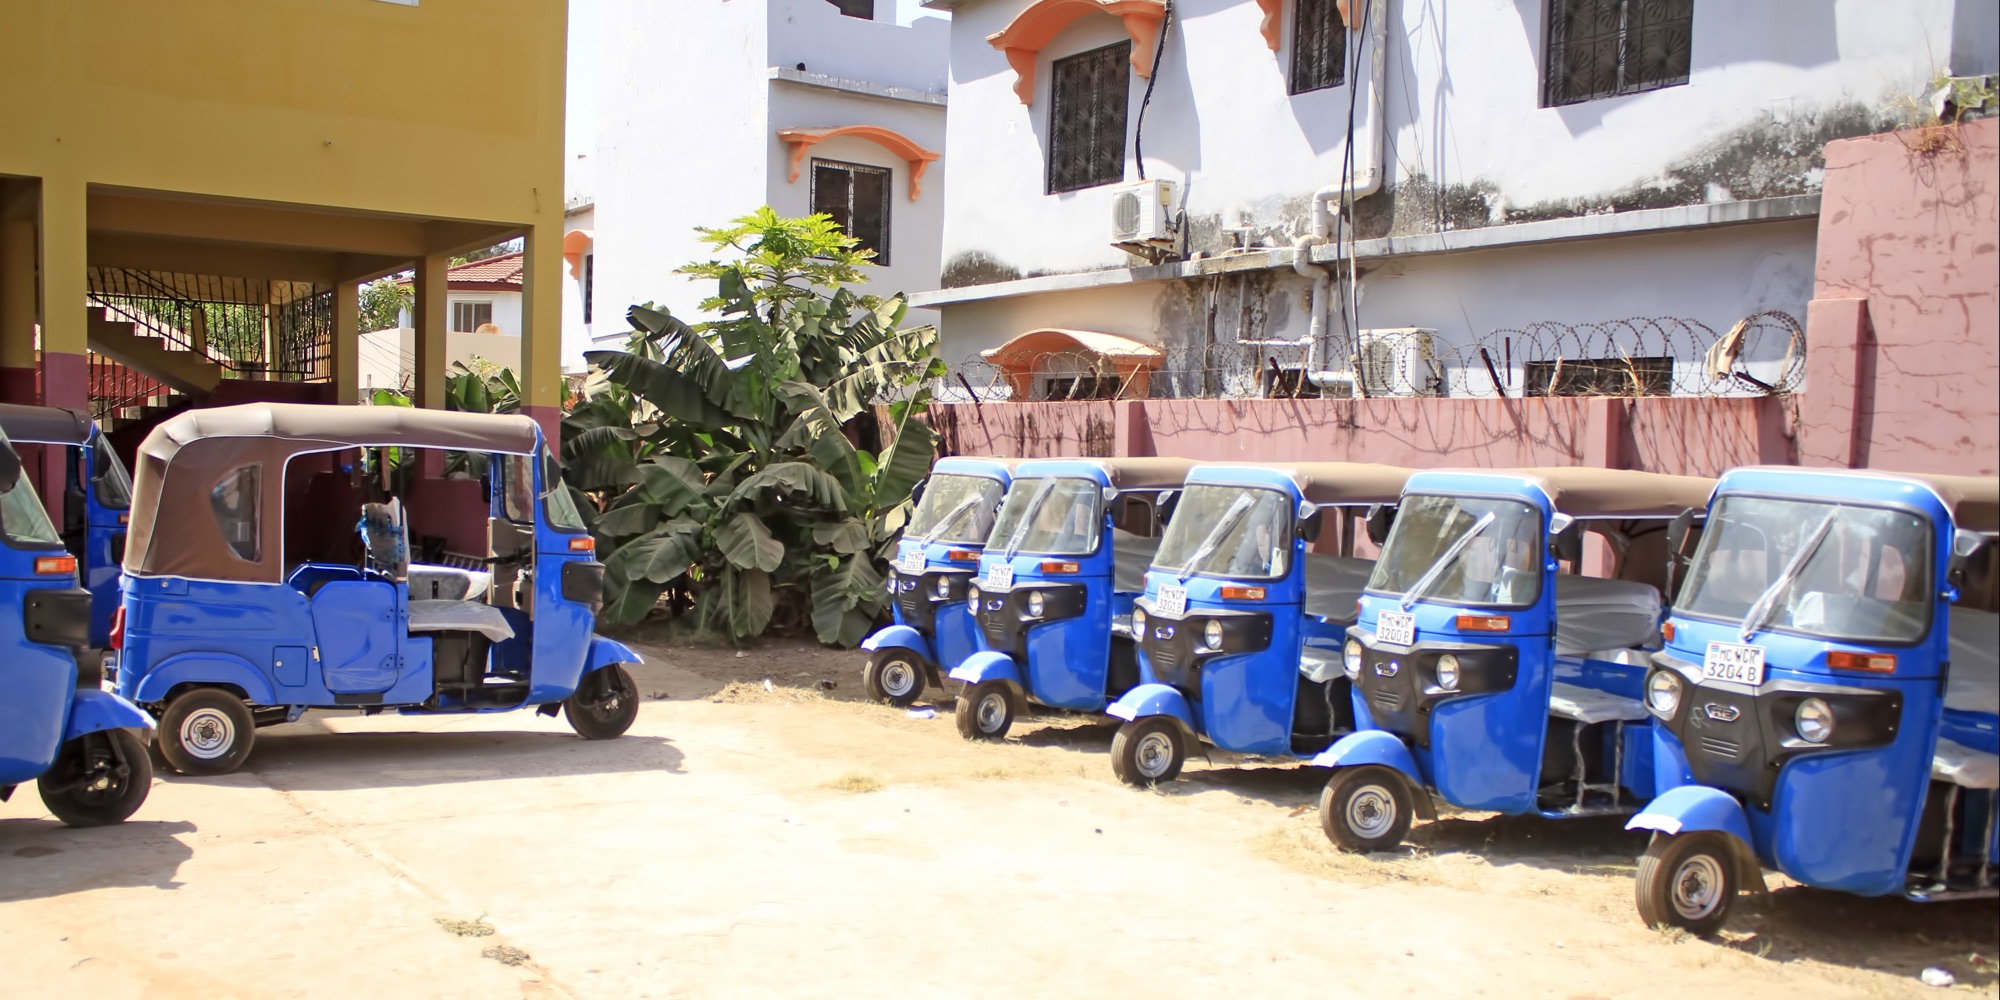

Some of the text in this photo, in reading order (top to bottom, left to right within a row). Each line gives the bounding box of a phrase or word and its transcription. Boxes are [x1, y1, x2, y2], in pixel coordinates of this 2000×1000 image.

[1379, 627, 1410, 643] 3200 B
[1719, 647, 1757, 664] MC WCR
[1707, 661, 1757, 682] 3204 B
